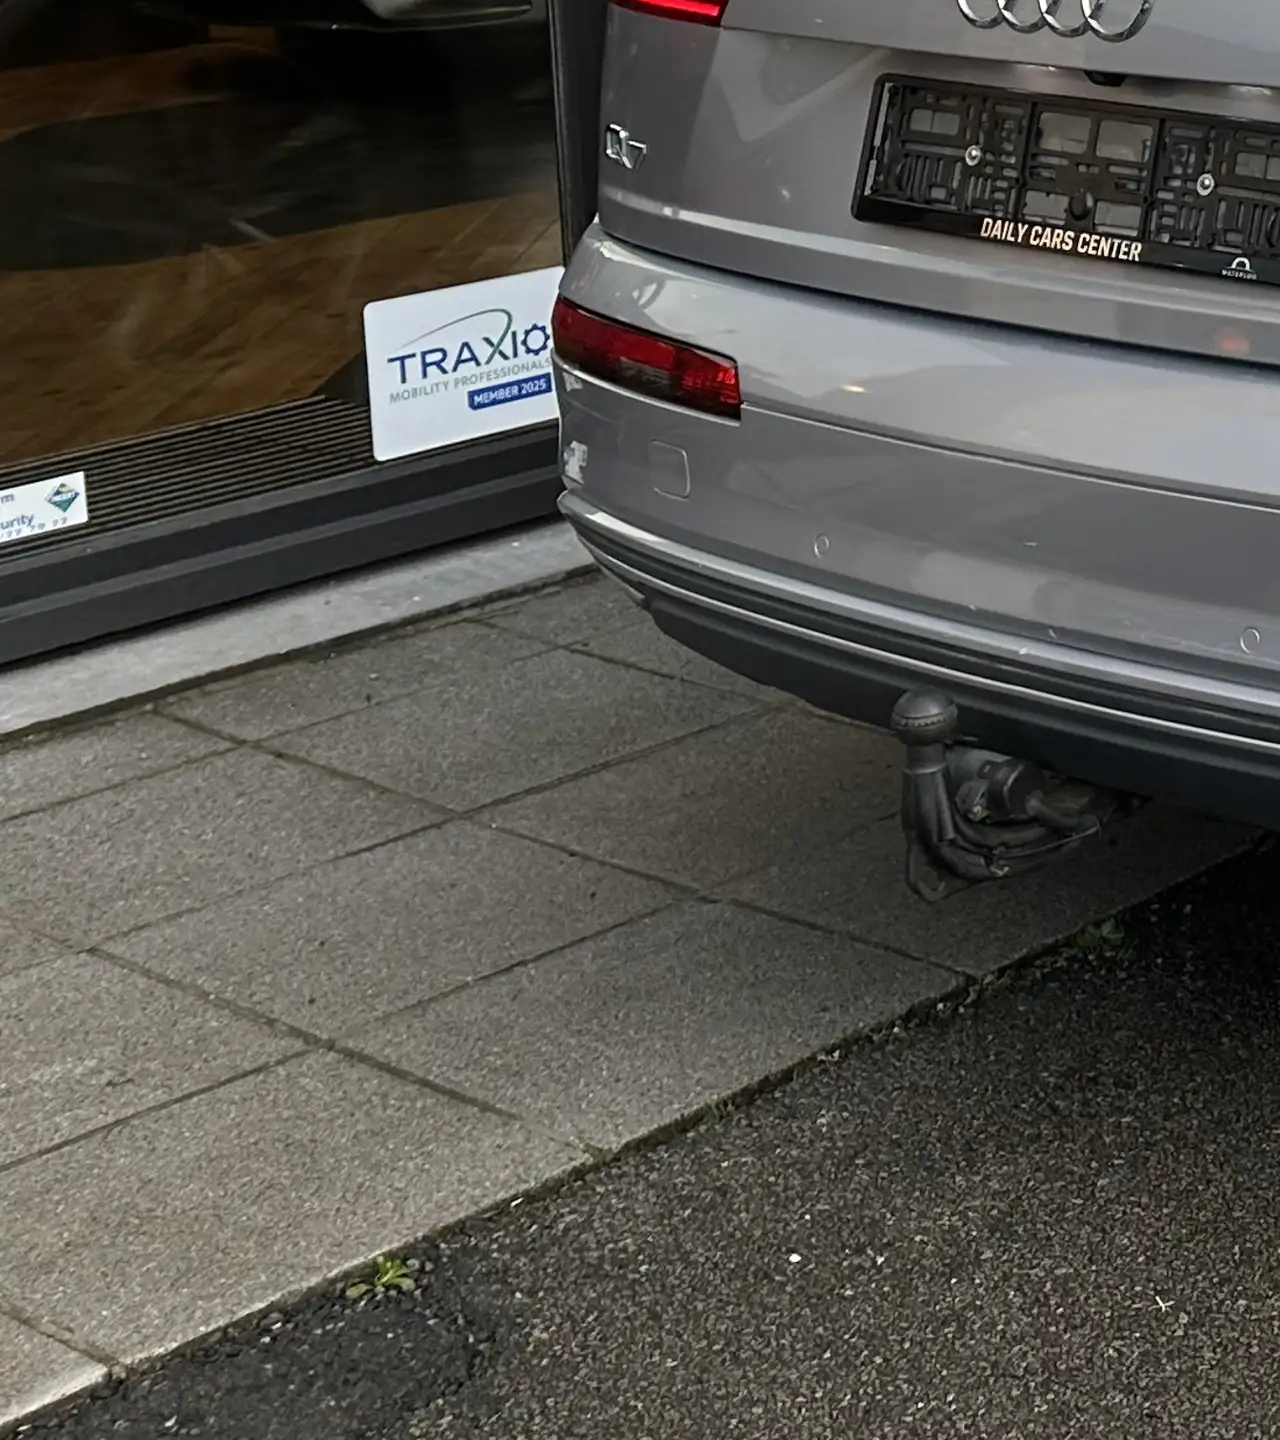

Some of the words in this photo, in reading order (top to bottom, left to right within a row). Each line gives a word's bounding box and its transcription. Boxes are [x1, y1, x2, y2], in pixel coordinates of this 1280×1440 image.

[980, 217, 1029, 243] DAILY
[1029, 225, 1075, 251] CARS
[1076, 232, 1142, 262] CENTER
[387, 322, 550, 385] TRAXIO
[389, 380, 451, 404] MOBILITY
[473, 382, 520, 405] MEMBER
[521, 379, 548, 394] 2025
